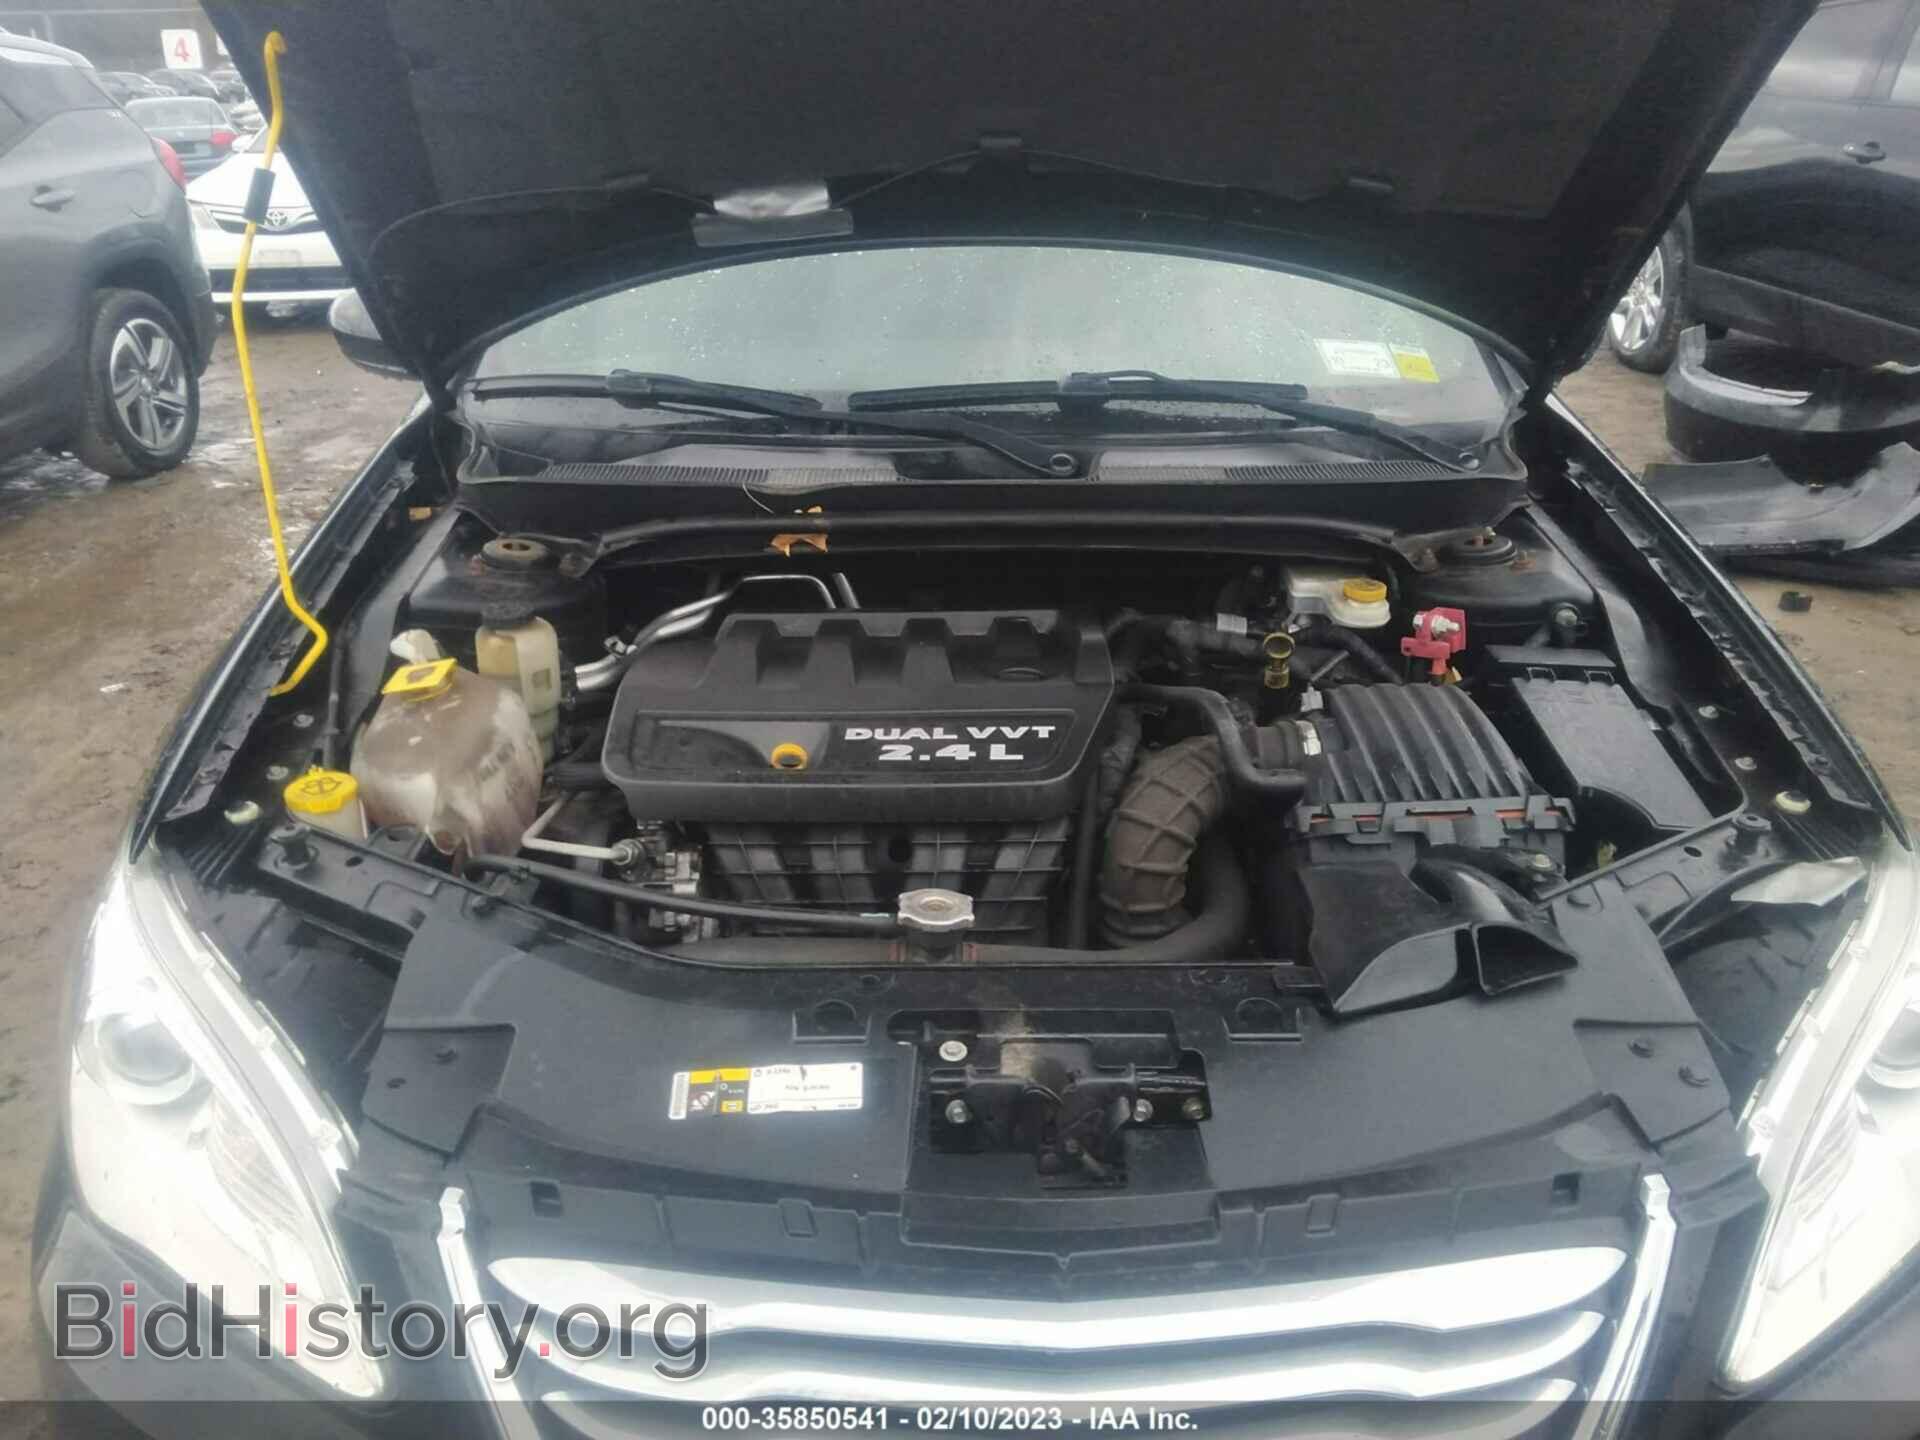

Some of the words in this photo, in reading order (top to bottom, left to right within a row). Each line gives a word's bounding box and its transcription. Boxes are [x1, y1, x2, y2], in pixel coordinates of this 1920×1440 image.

[174, 36, 192, 62] 4
[844, 727, 958, 740] DUAL
[966, 726, 1056, 739] VVT
[878, 744, 977, 760] 2.4
[989, 744, 1024, 760] L
